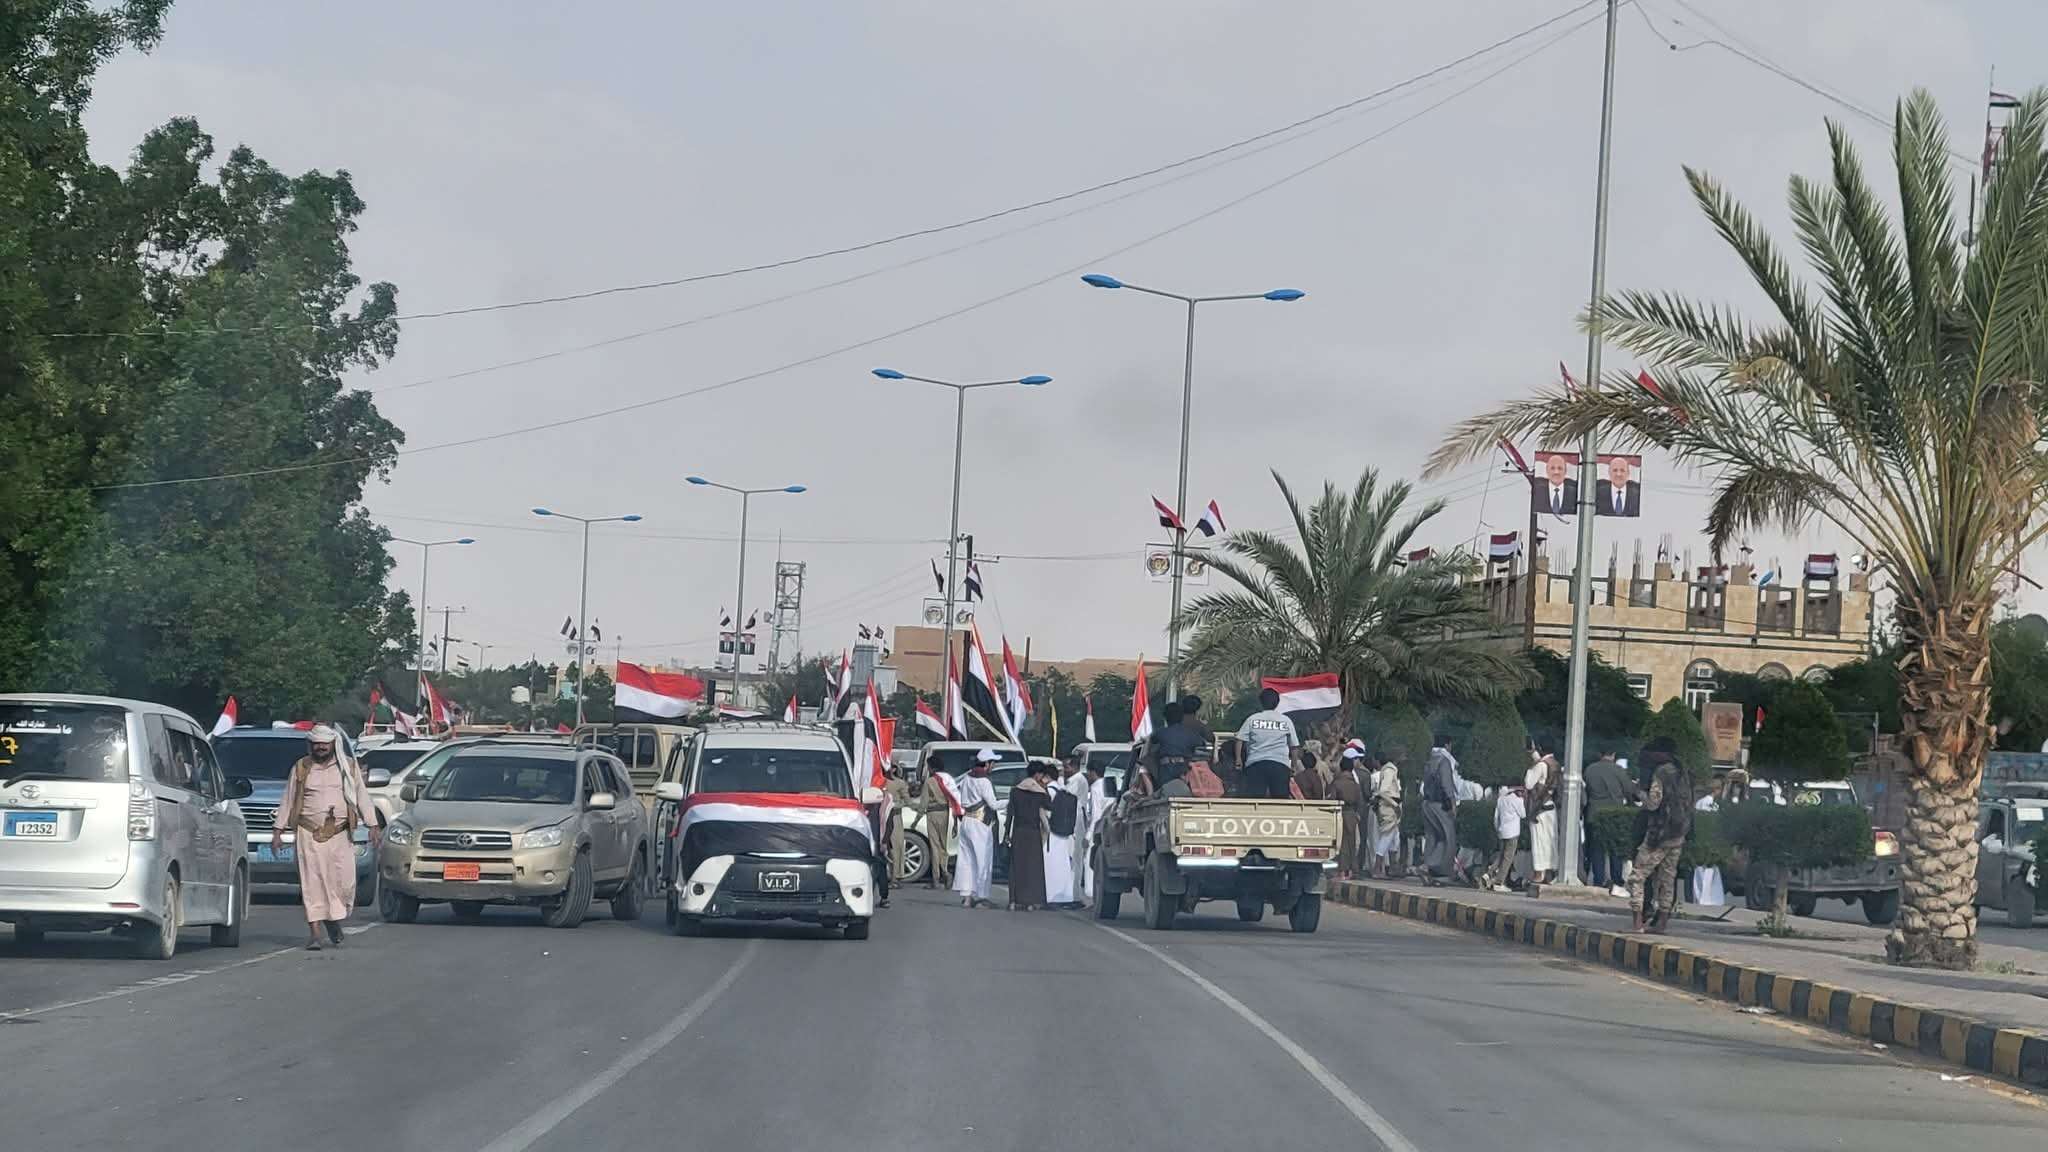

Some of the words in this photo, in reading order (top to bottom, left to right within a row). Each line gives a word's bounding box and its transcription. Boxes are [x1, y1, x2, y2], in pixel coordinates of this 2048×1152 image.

[1252, 719, 1288, 731] SMILE
[21, 823, 53, 835] 12352
[1205, 818, 1310, 837] TOYOTA
[765, 878, 792, 888] V.I.P.
